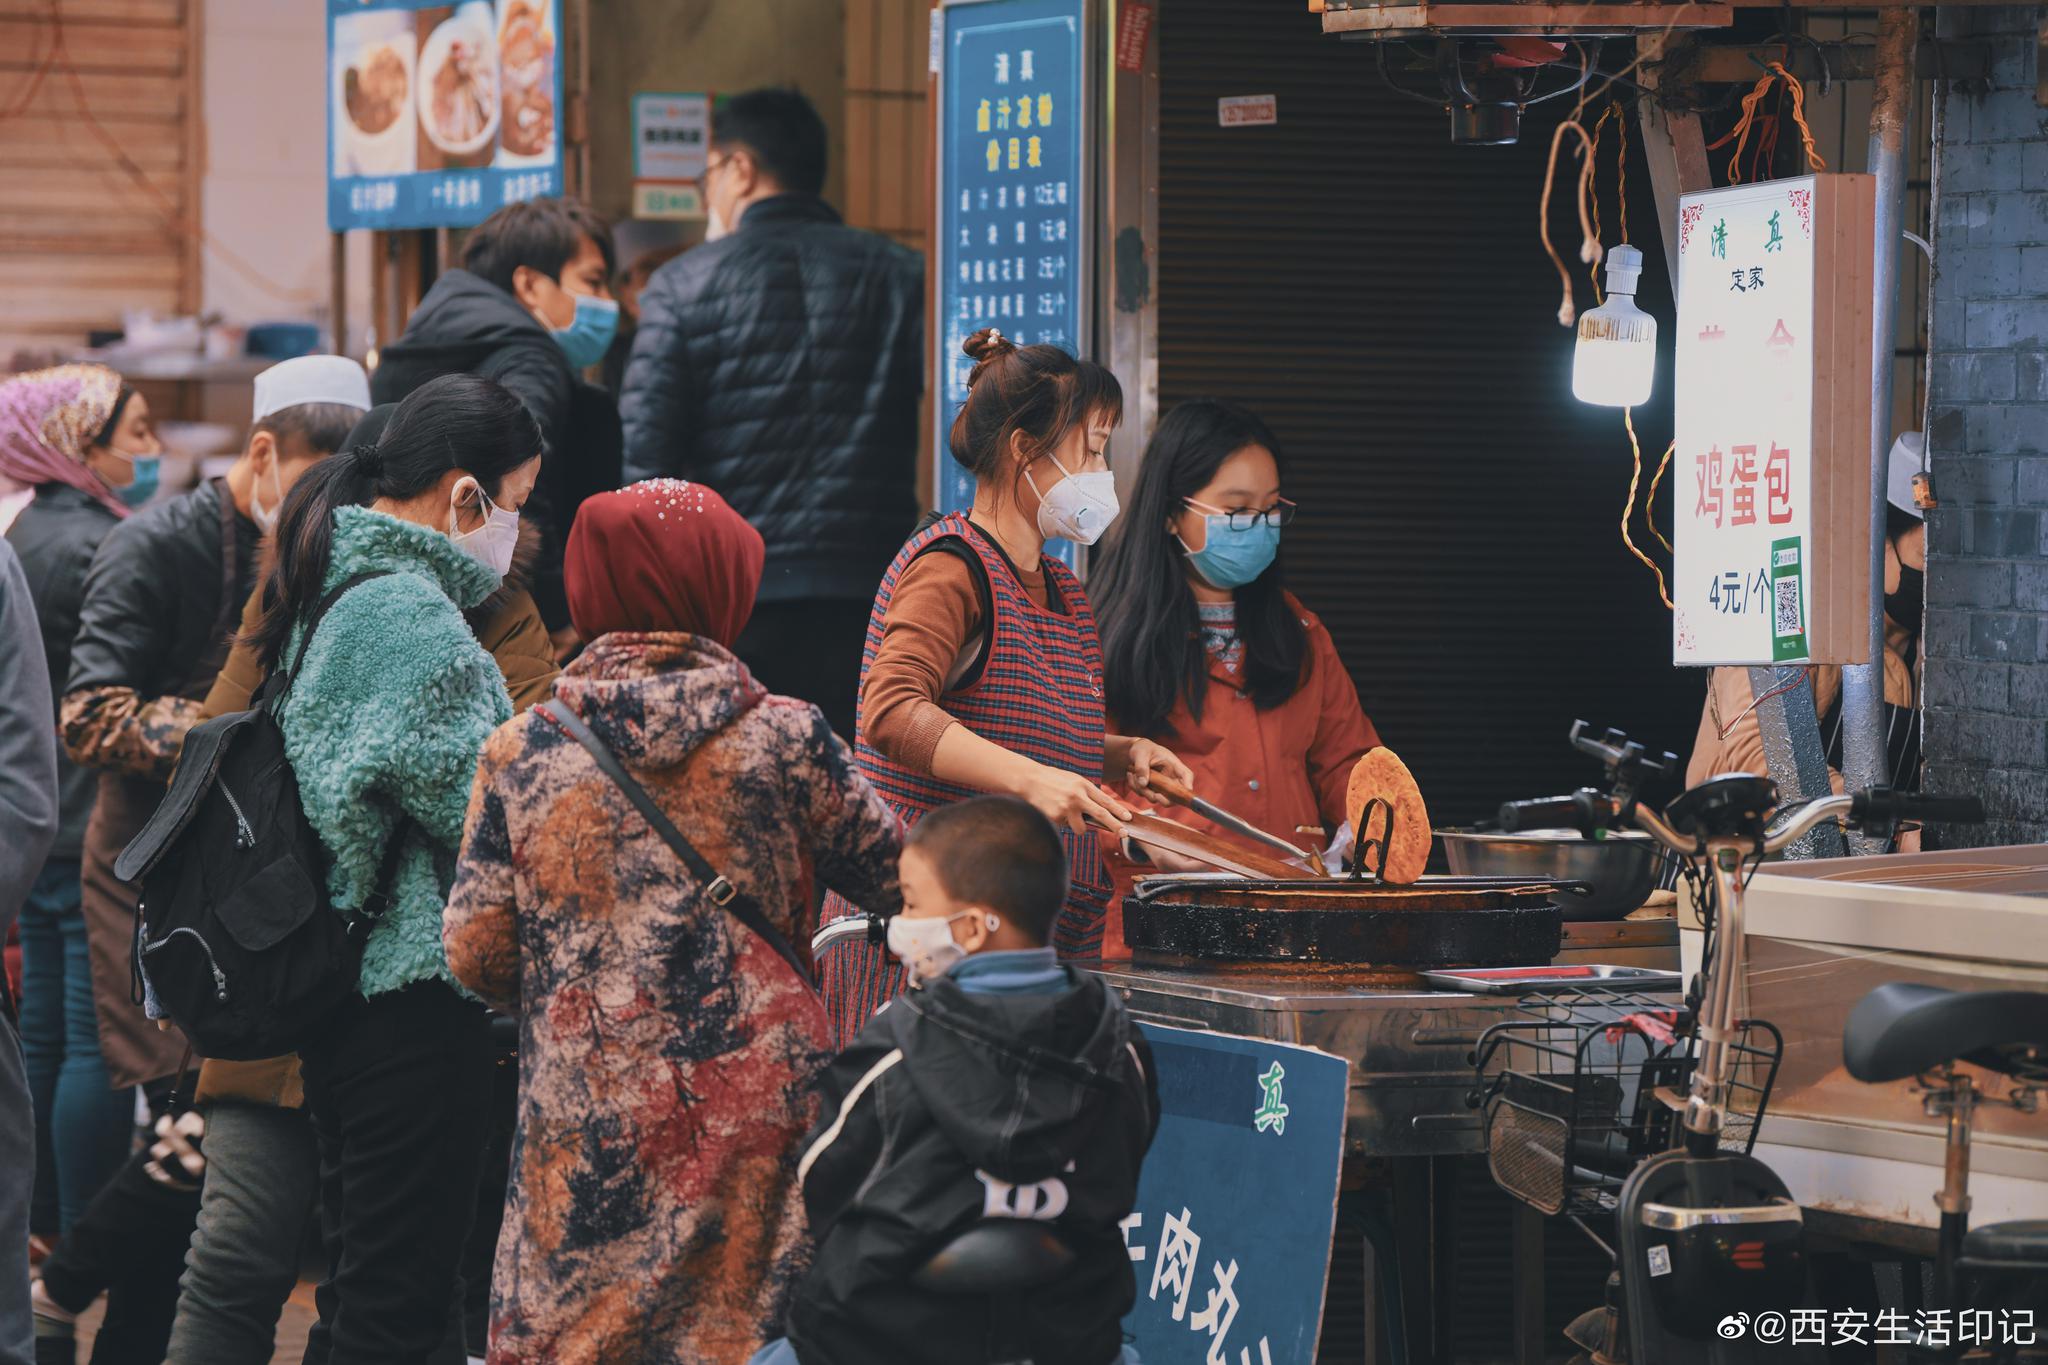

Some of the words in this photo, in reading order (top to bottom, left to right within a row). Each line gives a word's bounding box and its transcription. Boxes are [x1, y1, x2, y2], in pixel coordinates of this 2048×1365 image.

[1711, 209, 1783, 260] 清真
[1696, 440, 1793, 529] 鸡蛋包
[1709, 567, 1771, 614] 4元/个
[1254, 1060, 1289, 1136] 真
[1118, 1207, 1272, 1365] 肉丸
